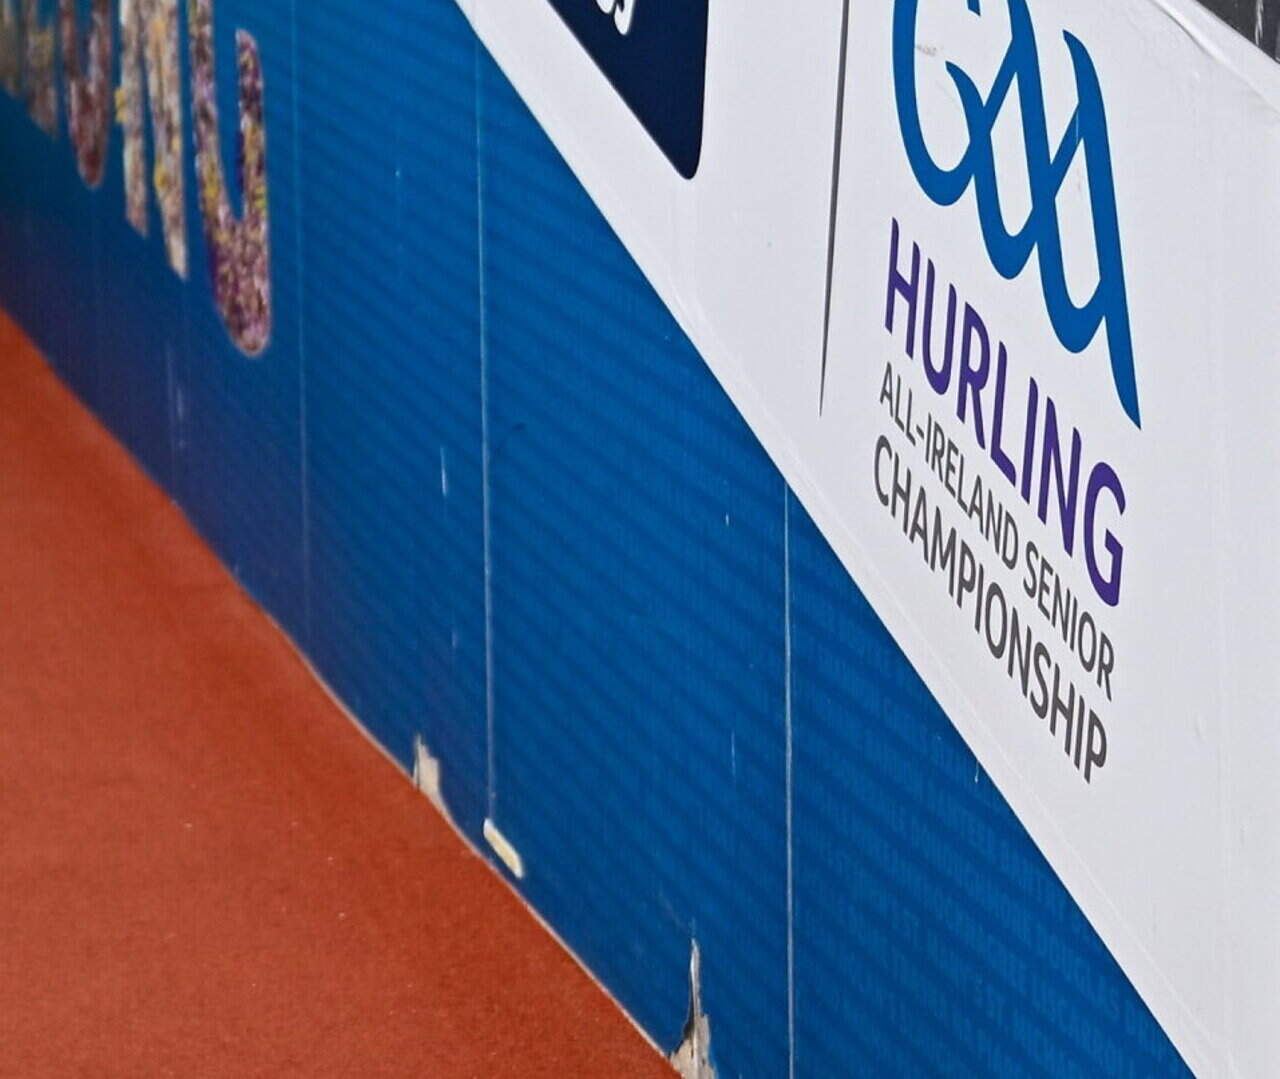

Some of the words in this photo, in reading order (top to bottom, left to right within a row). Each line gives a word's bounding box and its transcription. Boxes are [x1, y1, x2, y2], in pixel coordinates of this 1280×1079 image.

[878, 361, 1020, 574] ALL-IRELAND
[1023, 540, 1117, 704] SENIOR
[885, 217, 1128, 608] HURLING
[873, 434, 1109, 785] CHAMPIONSHIP
